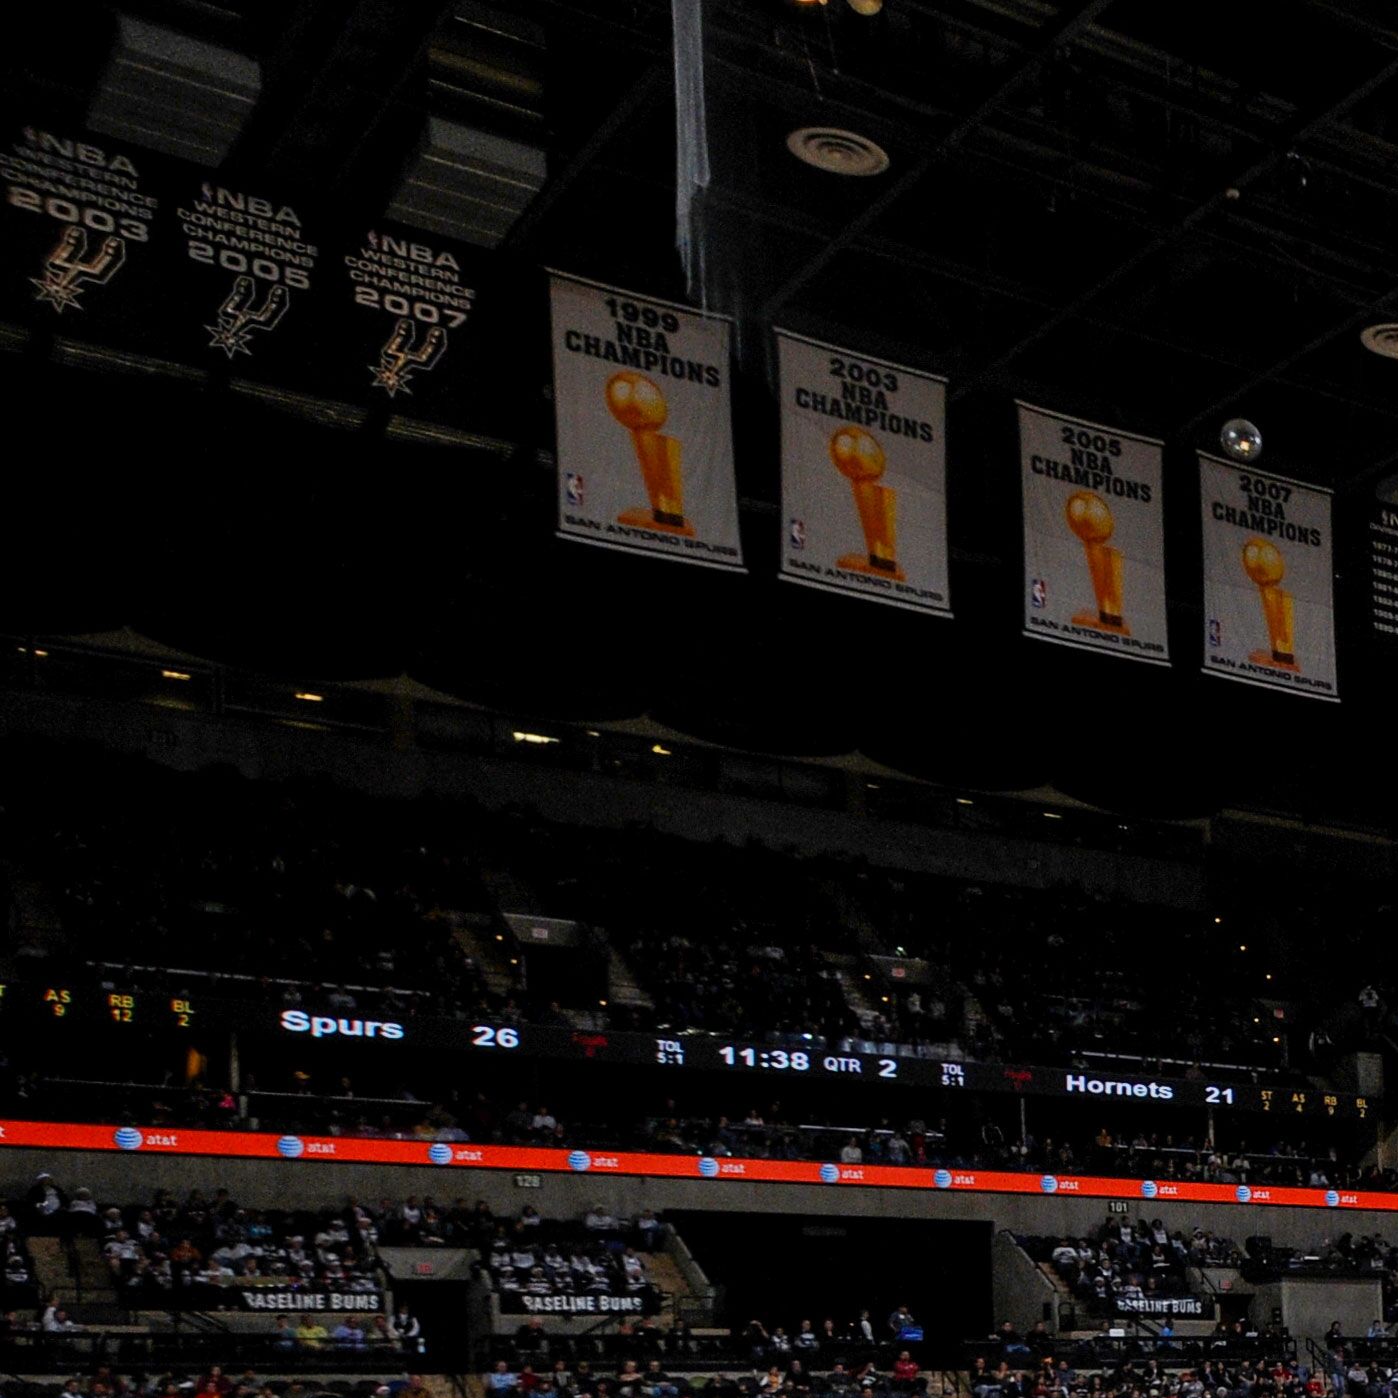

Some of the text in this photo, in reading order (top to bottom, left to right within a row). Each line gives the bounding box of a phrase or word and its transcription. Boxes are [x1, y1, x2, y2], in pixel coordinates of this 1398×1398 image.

[12, 143, 138, 190] WESTERN
[41, 132, 140, 177] NBA
[1, 167, 154, 220] CHAMPIONS
[6, 184, 150, 243] 2003
[216, 185, 304, 229] NBA
[176, 206, 320, 257] CONFERENCE
[193, 199, 302, 240] WESTERN
[182, 222, 315, 268] CHAMPIONS
[187, 240, 311, 291] 2005
[359, 246, 460, 283] WESTERN
[381, 233, 461, 272] NBA
[343, 254, 478, 300] CONFERENCE
[349, 269, 472, 310] CHAMPIONS
[354, 285, 468, 328] 2007
[605, 298, 681, 334] 1999
[615, 320, 671, 355] NBA
[564, 329, 721, 389] CHAMPIONS
[828, 357, 900, 394] 2003
[794, 387, 934, 443] CHAMPIONS
[840, 380, 889, 411] NBA
[1062, 425, 1122, 457] 2005
[1070, 447, 1113, 476] NBA
[1029, 454, 1153, 504] CHAMPIONS
[1239, 473, 1294, 504] 2007
[1210, 502, 1322, 548] CHAMPIONS
[1246, 494, 1287, 520] NBA
[281, 1009, 1234, 1105] Spurs 26 TOL 11:38 QTR 2 TOL Hornets 21
[656, 1051, 685, 1065] 5:1
[941, 1074, 965, 1087] 5:1
[146, 1133, 179, 1148] at&t
